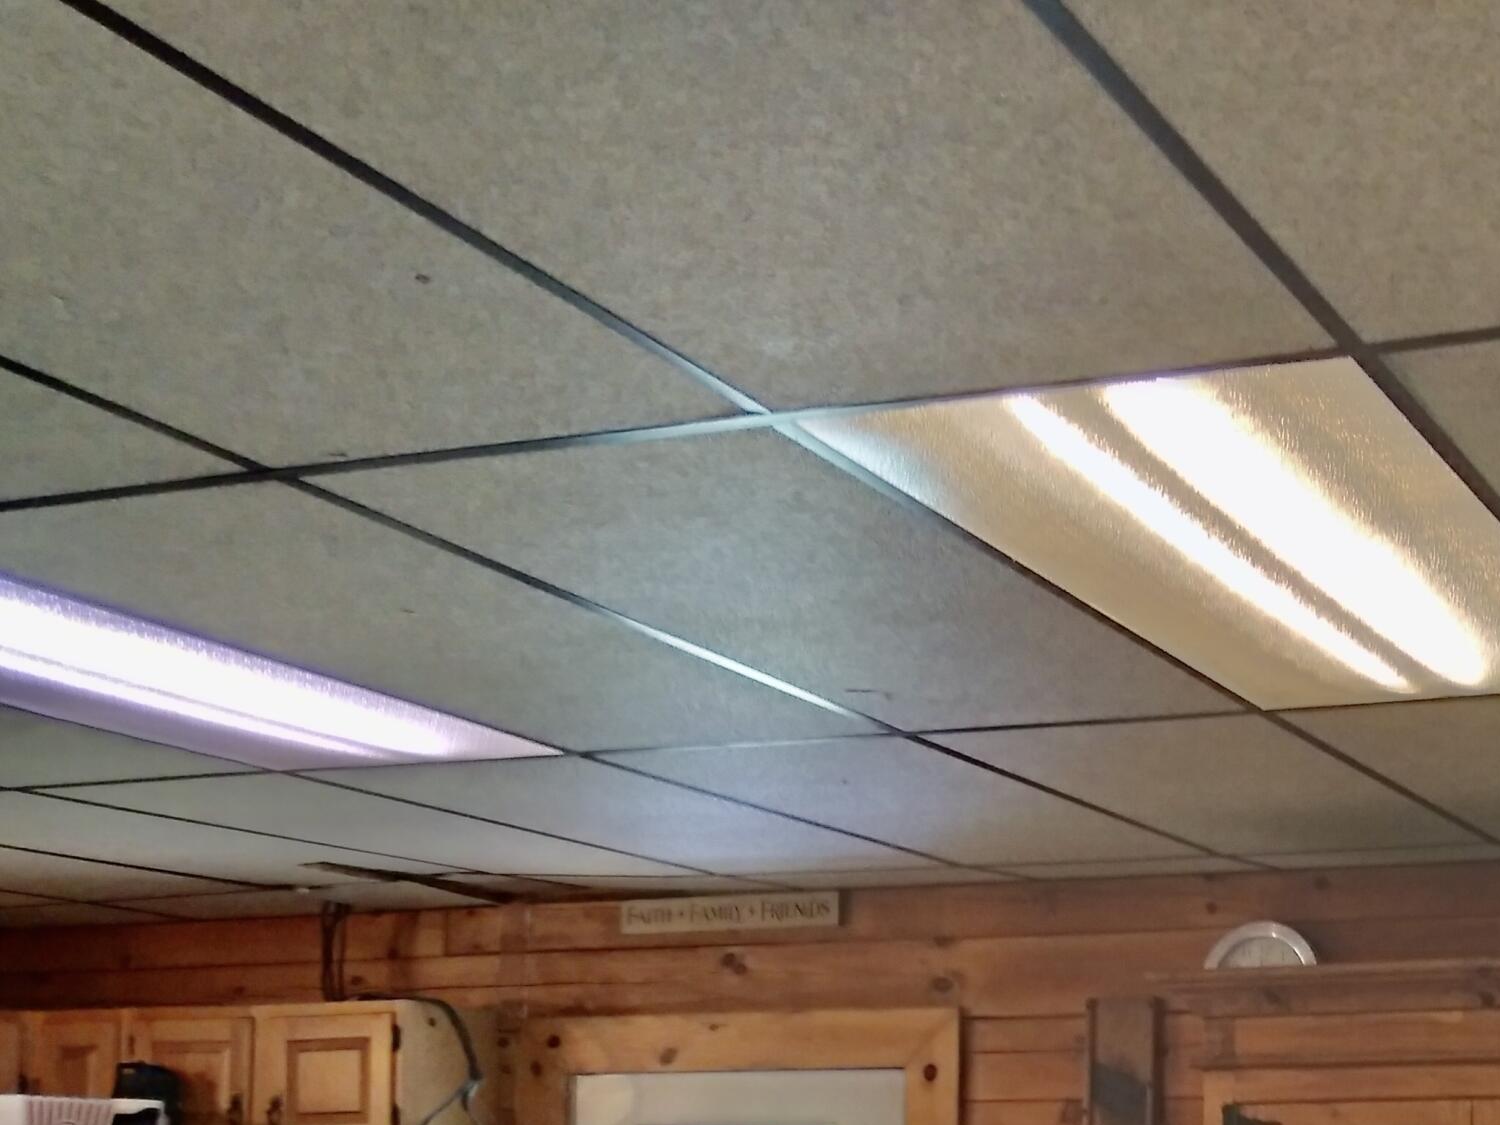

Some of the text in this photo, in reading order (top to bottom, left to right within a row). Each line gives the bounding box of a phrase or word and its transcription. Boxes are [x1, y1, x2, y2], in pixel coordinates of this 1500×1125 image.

[627, 898, 831, 926] FAITH FAMILY FRIENDS
